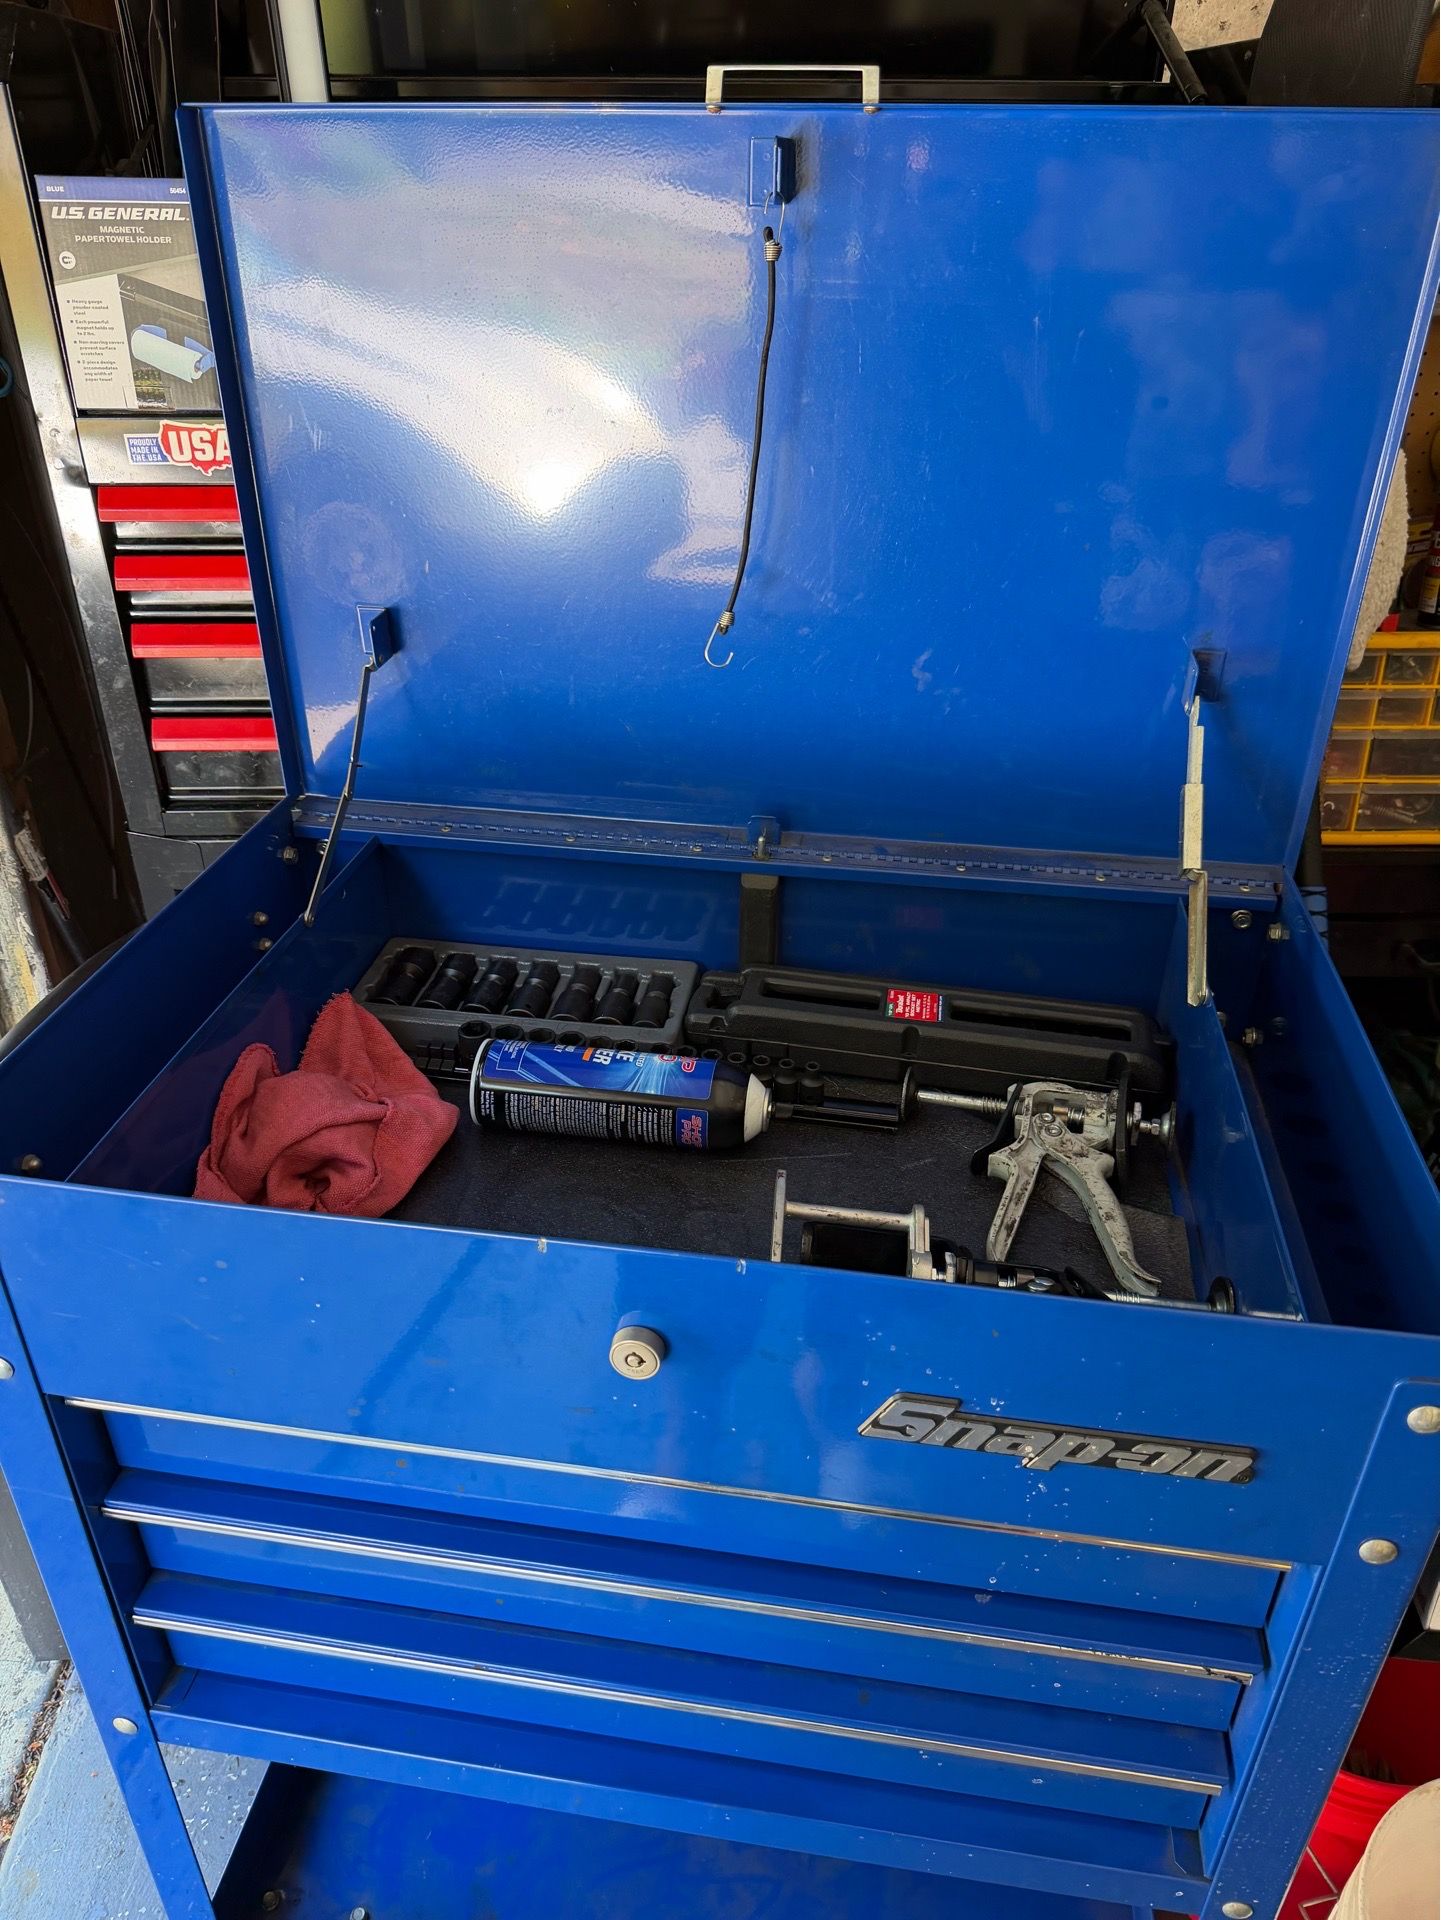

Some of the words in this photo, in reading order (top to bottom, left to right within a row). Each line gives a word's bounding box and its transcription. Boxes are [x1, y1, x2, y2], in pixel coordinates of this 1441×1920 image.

[51, 206, 85, 219] U.S.
[99, 226, 144, 234] MAGNETIC
[136, 236, 172, 244] HOLDER
[129, 438, 157, 446] PROUDLY
[168, 430, 231, 462] USA
[131, 446, 150, 454] MADE
[151, 446, 159, 454] IN
[870, 1399, 1253, 1483] Snap-on
